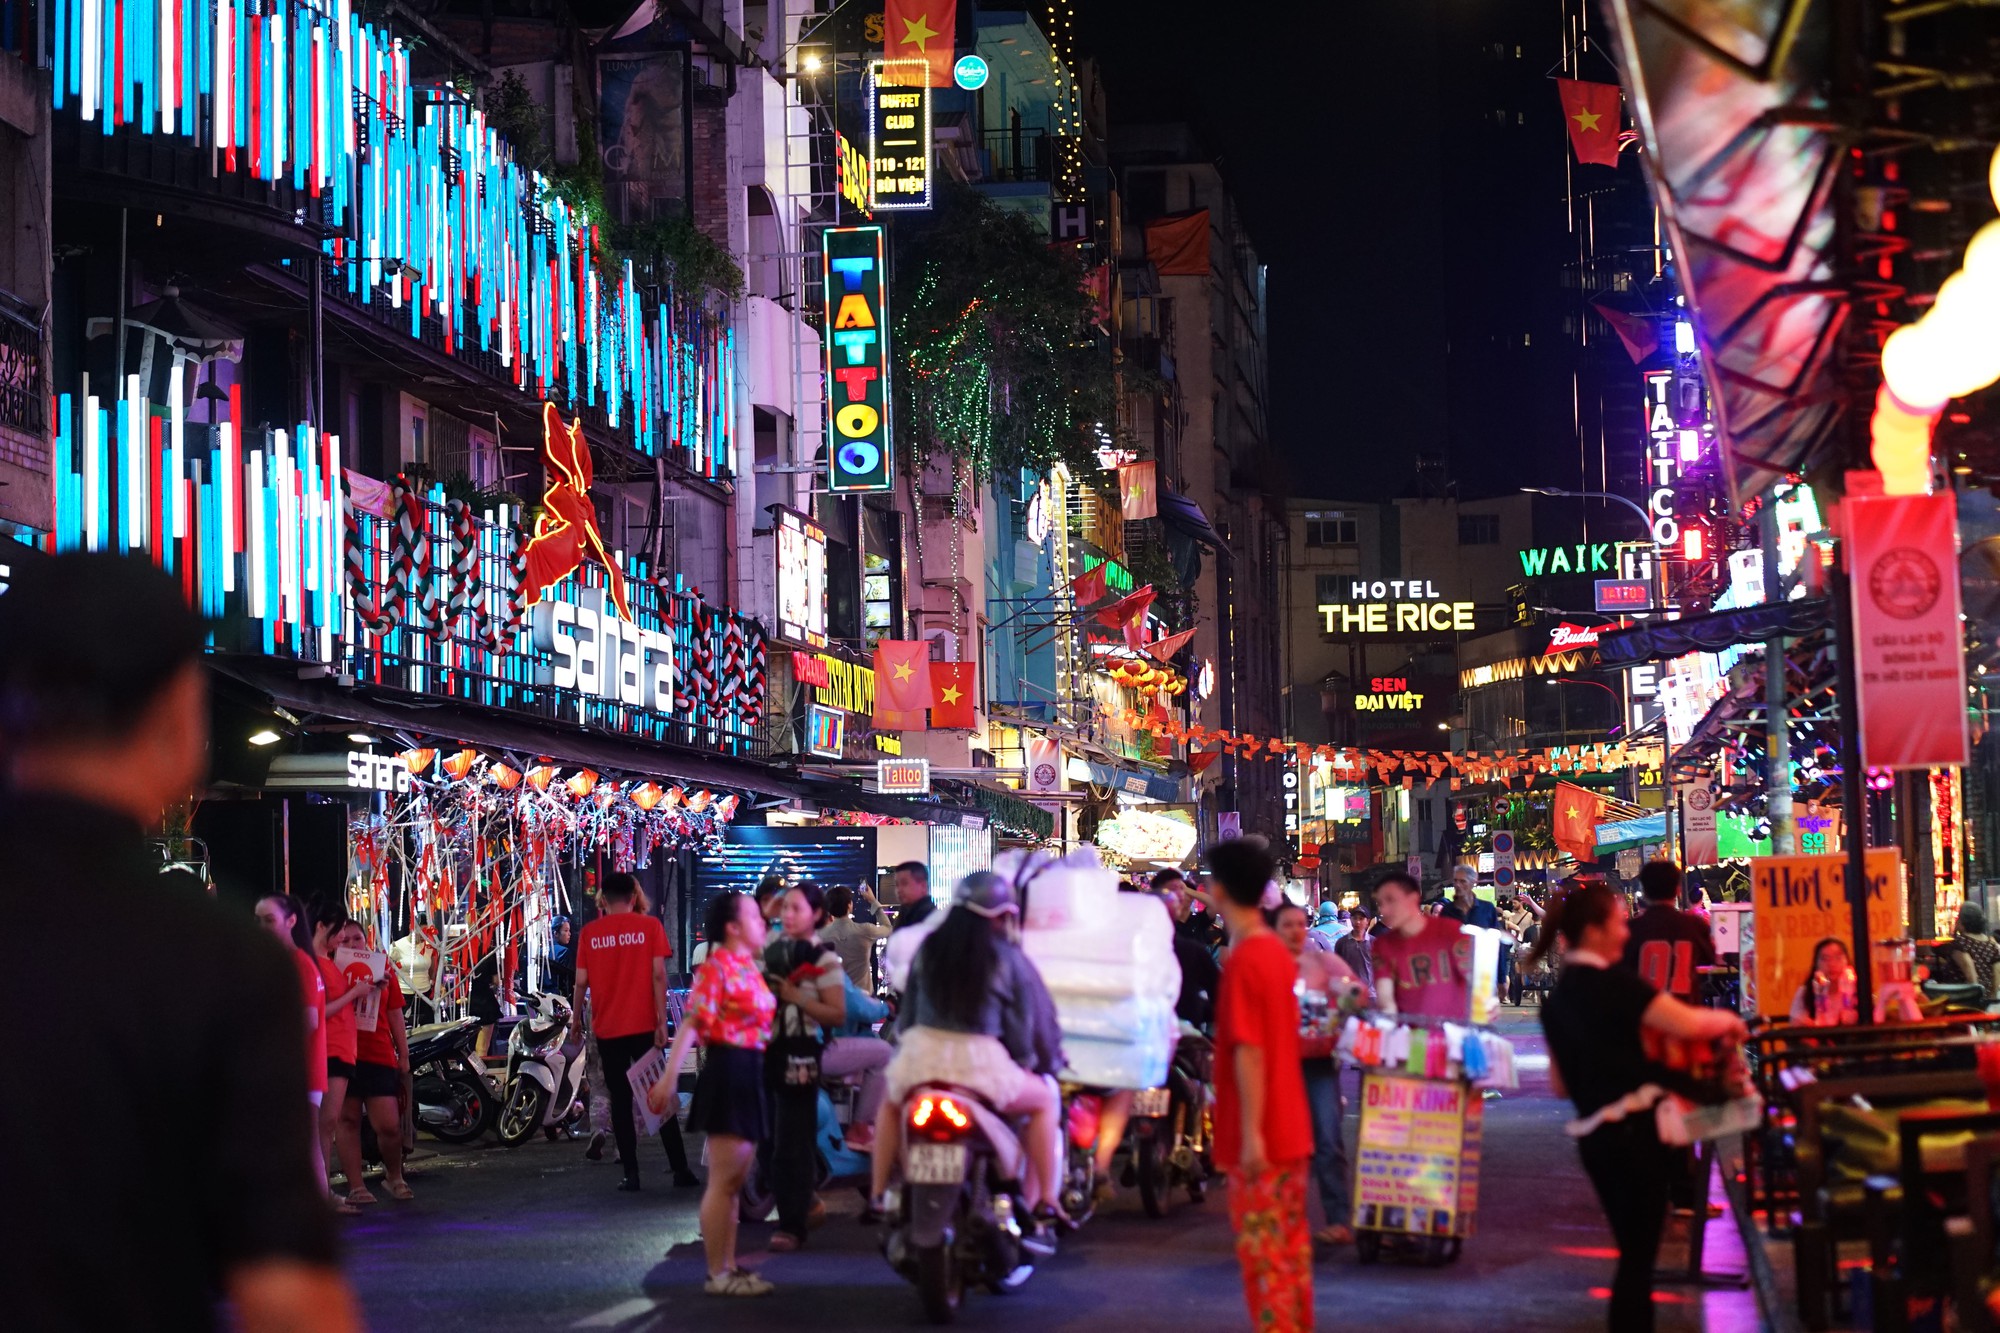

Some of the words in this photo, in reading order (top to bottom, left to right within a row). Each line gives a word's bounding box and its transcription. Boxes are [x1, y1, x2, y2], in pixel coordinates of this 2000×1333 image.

[880, 94, 920, 108] BUFFET
[886, 115, 914, 129] CLUB
[905, 157, 925, 170] 121
[831, 257, 879, 475] TATTOO
[1352, 580, 1440, 599] HOTEL
[1318, 604, 1388, 633] THE
[1396, 602, 1475, 632] RICE
[552, 587, 674, 713] sahara
[1371, 677, 1407, 692] SEN
[1355, 694, 1383, 712] ĐẠI
[1386, 690, 1424, 712] VIỆT
[347, 744, 409, 793] sahara
[884, 765, 921, 783] Tattoo
[1796, 815, 1833, 833] Tiger
[591, 934, 616, 950] CLUB
[619, 931, 645, 946] COCO
